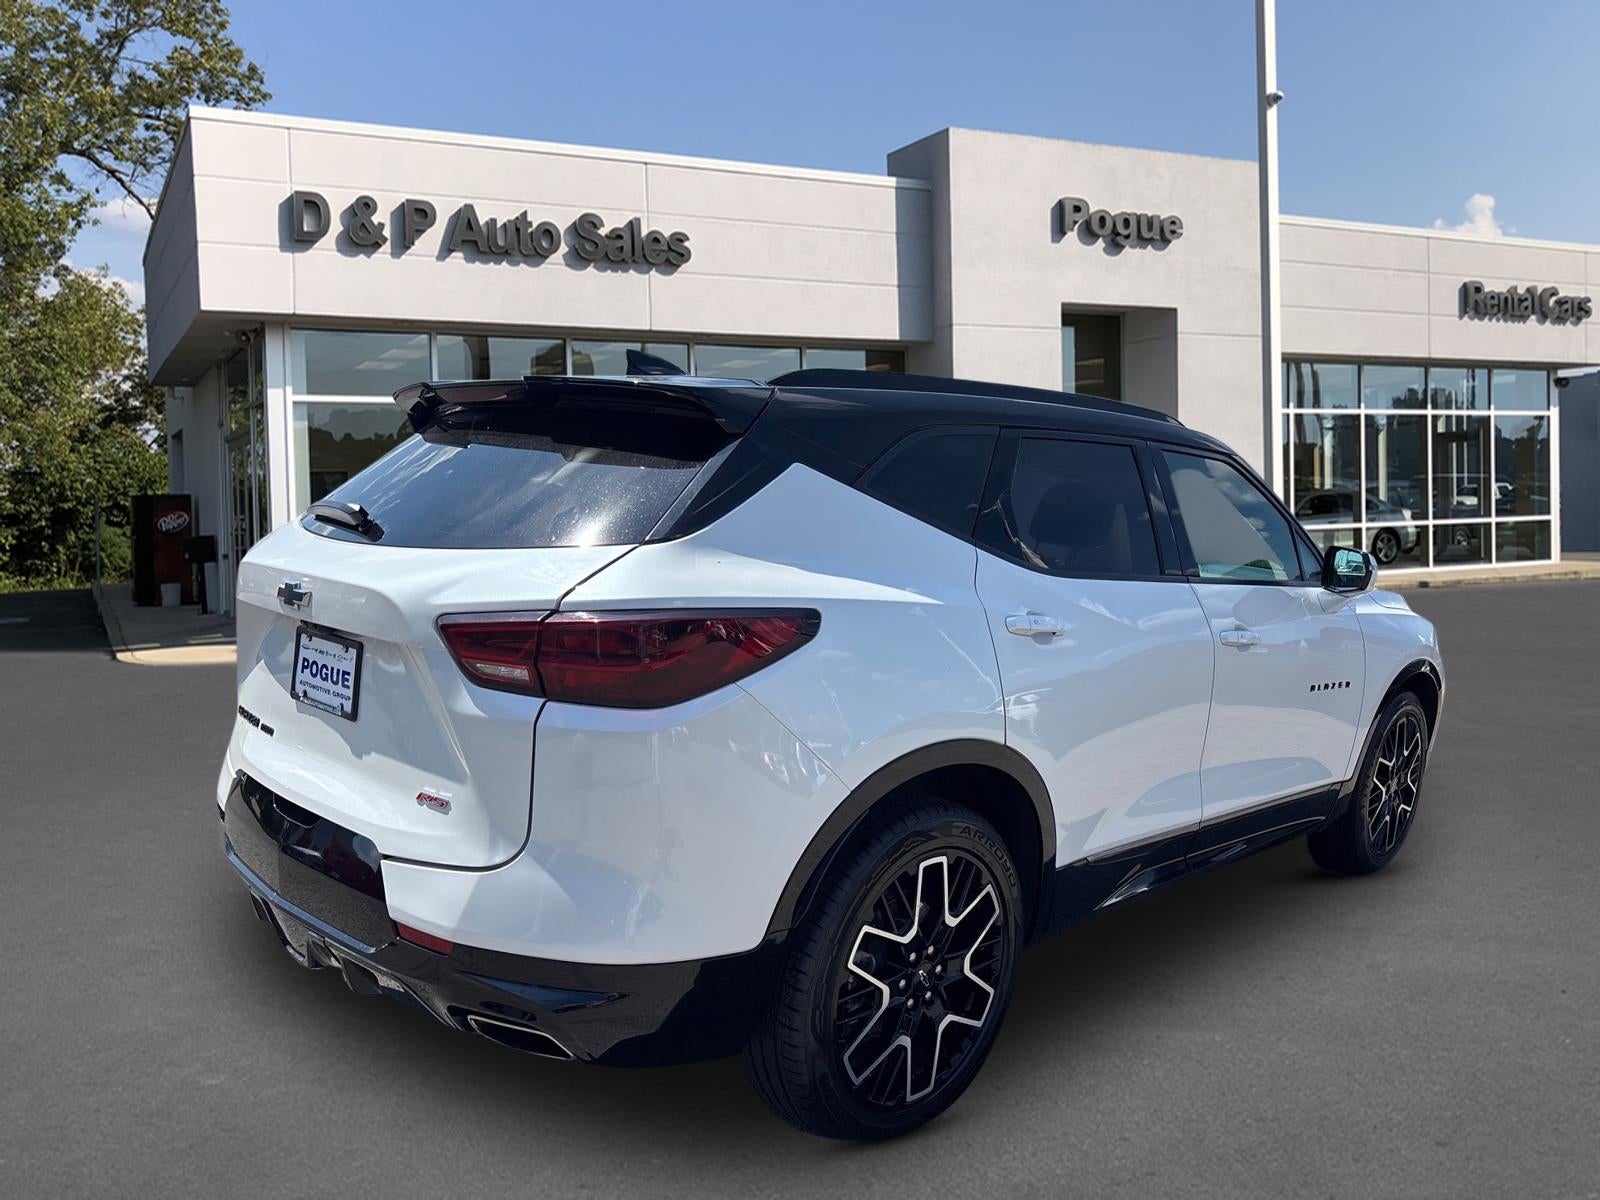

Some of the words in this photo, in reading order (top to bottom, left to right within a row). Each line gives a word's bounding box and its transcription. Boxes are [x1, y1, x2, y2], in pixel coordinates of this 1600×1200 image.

[292, 190, 331, 243] D
[349, 195, 389, 248] &
[403, 199, 437, 249] P
[448, 203, 562, 258] Auto
[573, 212, 692, 266] Sales
[1058, 196, 1183, 246] Pogue
[1462, 280, 1538, 318] Rental
[1539, 286, 1592, 322] Cars
[299, 679, 331, 696] AUTOMOTIVE
[332, 690, 351, 701] GROUP
[301, 656, 351, 690] POGUE
[1310, 681, 1351, 692] BLAZER
[416, 792, 449, 809] RS
[959, 825, 1017, 888] ARROYO
